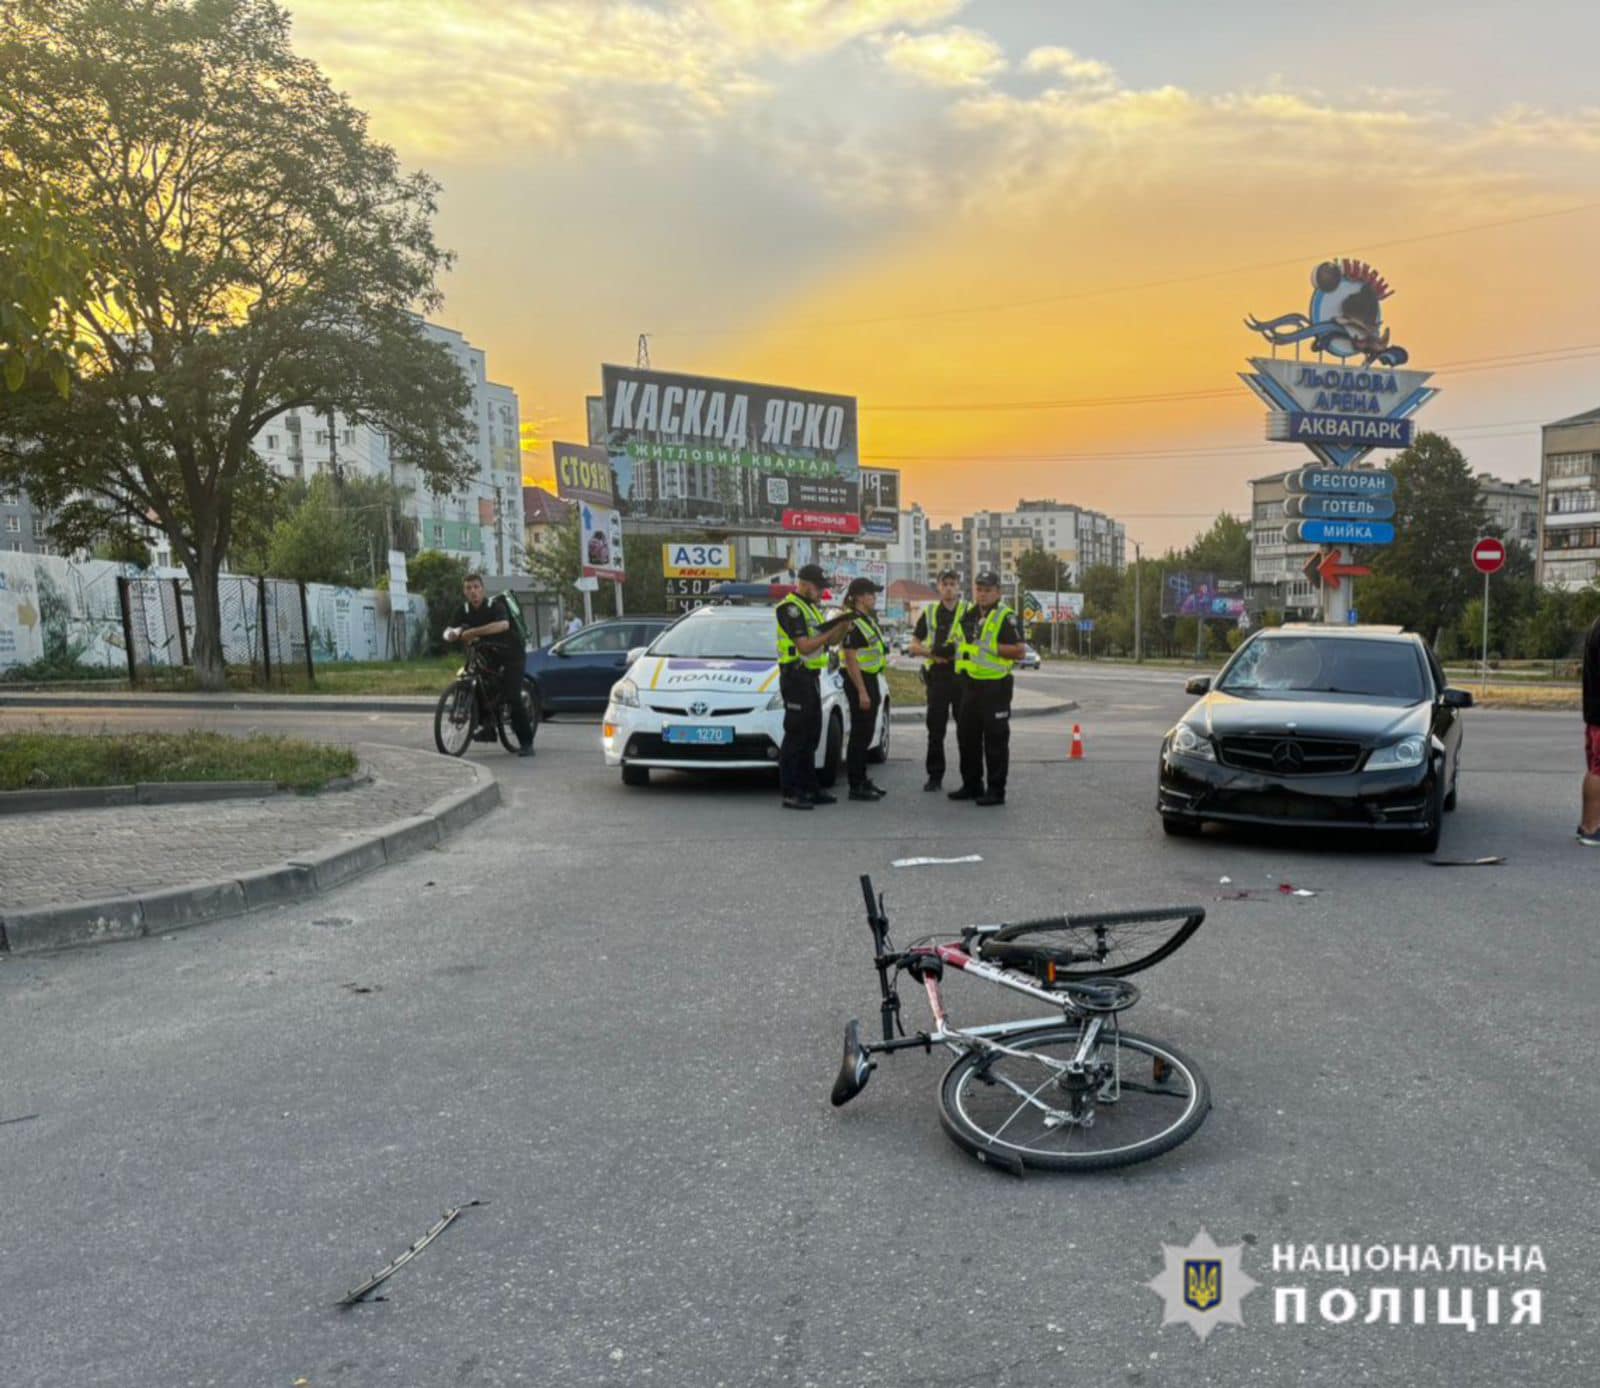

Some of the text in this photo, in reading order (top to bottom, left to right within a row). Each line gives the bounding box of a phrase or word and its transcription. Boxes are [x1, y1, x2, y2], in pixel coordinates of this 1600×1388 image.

[1297, 367, 1399, 394] ЛЬОДОВА
[1314, 391, 1381, 414] АРЕНА
[611, 379, 844, 450] КАСКАД ЯРКО
[1298, 417, 1402, 439] АКВАПАРК
[635, 444, 830, 473] ЖИТЛОВИЙ КВАРТАЛ
[1312, 473, 1386, 489] РЕСТОРАН
[1322, 500, 1375, 514] ГОТЕЛЬ
[1323, 522, 1373, 538] МИЙКА
[674, 546, 722, 566] АЗС
[668, 673, 753, 685] ПОЛІЦІЯ
[695, 728, 723, 740] 1270
